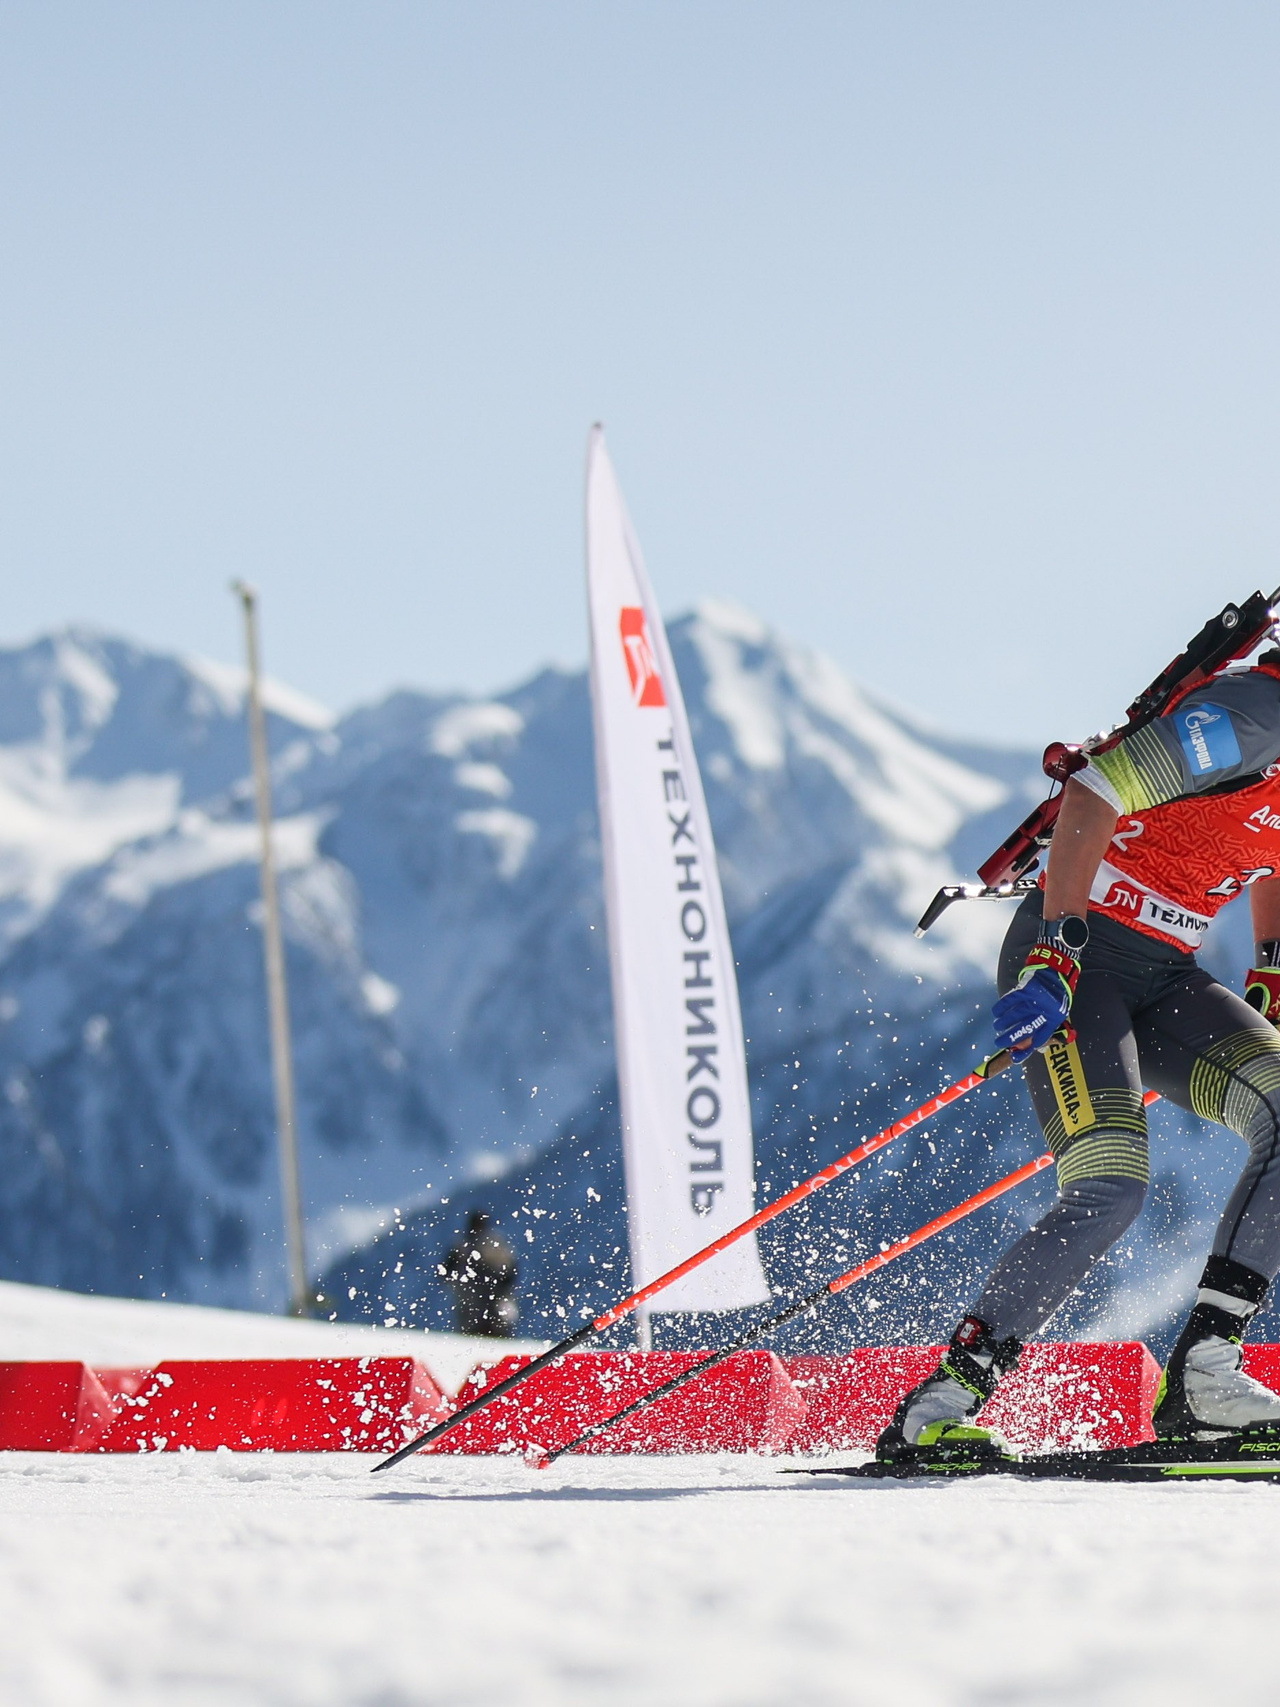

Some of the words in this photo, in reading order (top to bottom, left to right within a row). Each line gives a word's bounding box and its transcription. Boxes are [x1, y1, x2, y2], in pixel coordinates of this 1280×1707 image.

[1111, 820, 1144, 852] 2
[657, 728, 724, 1218] ТЕХНОНИКОЛЬ
[940, 1361, 987, 1400] FISCHER
[925, 1462, 982, 1472] FISCHER
